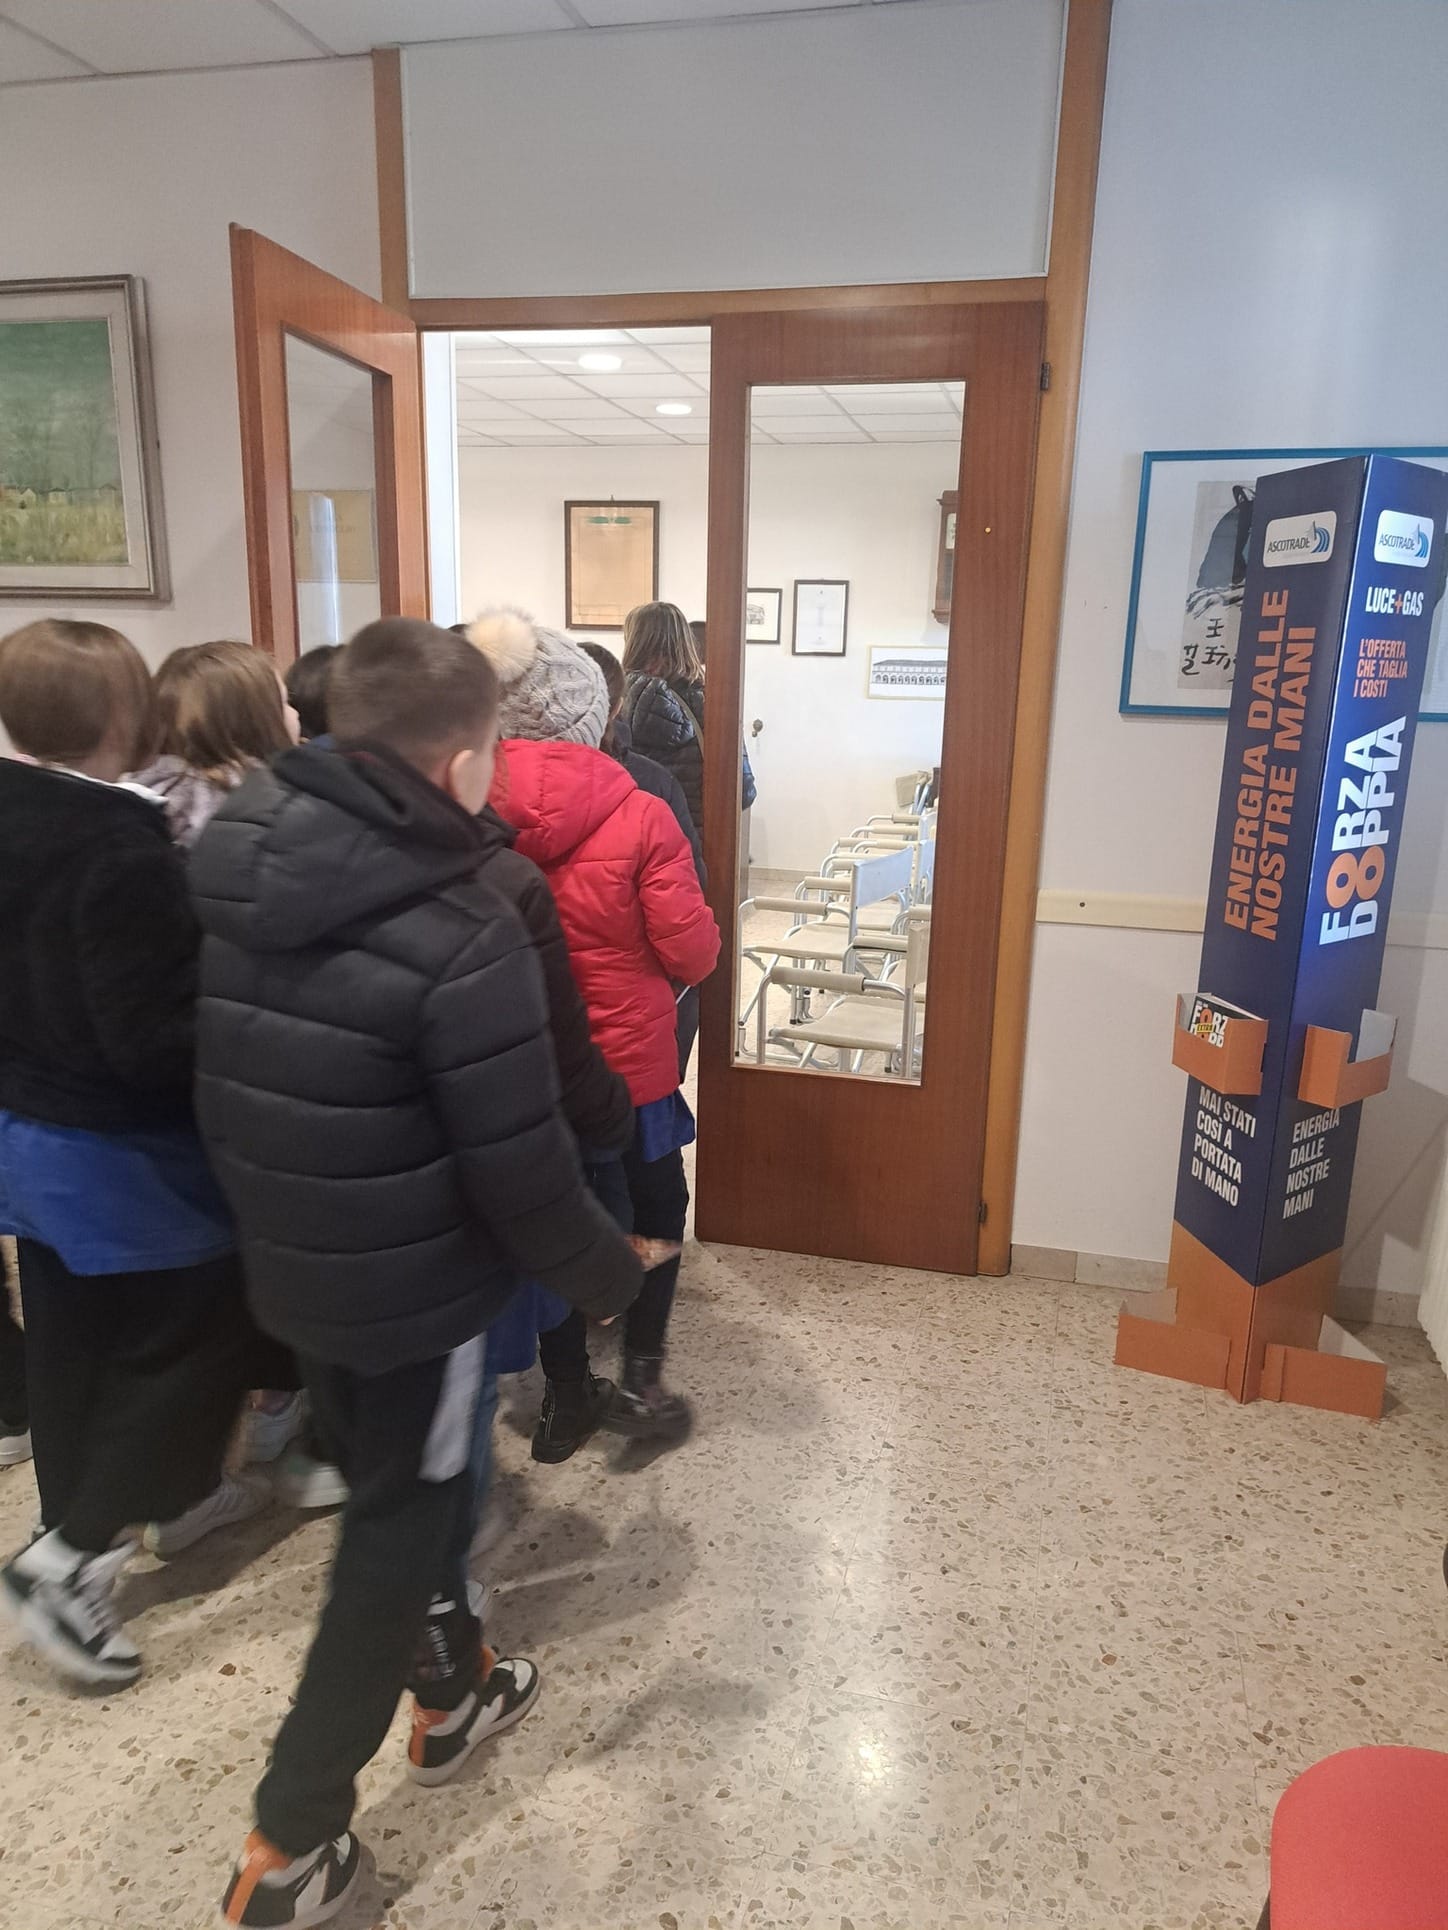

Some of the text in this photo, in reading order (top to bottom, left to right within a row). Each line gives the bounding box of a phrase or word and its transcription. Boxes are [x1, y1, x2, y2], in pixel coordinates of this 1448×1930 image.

[1267, 537, 1311, 553] ASCOTRADE
[1378, 533, 1415, 551] ASCOTRADE
[1365, 586, 1424, 617] LUCE+GAS
[1359, 638, 1406, 659] L'OFFERTA
[1356, 659, 1408, 679] CHE TAGLIA
[1353, 679, 1388, 698] I COSTI
[1224, 589, 1289, 930] ENERGIA DALLE
[1250, 626, 1316, 942] NOSTRE MANI
[1319, 728, 1378, 946] FORZA
[1348, 715, 1407, 940] DOPPIA
[1192, 1004, 1229, 1036] FORZ
[1196, 1109, 1232, 1150] COSÌ A
[1199, 1086, 1257, 1138] MAI STATI
[1292, 1108, 1341, 1144] ENERGIA
[1193, 1133, 1242, 1184] PORTATA
[1289, 1137, 1326, 1169] DALLE
[1191, 1156, 1239, 1207] DI MANO
[1286, 1158, 1331, 1195] NOSTRE
[1282, 1188, 1315, 1219] MANI
